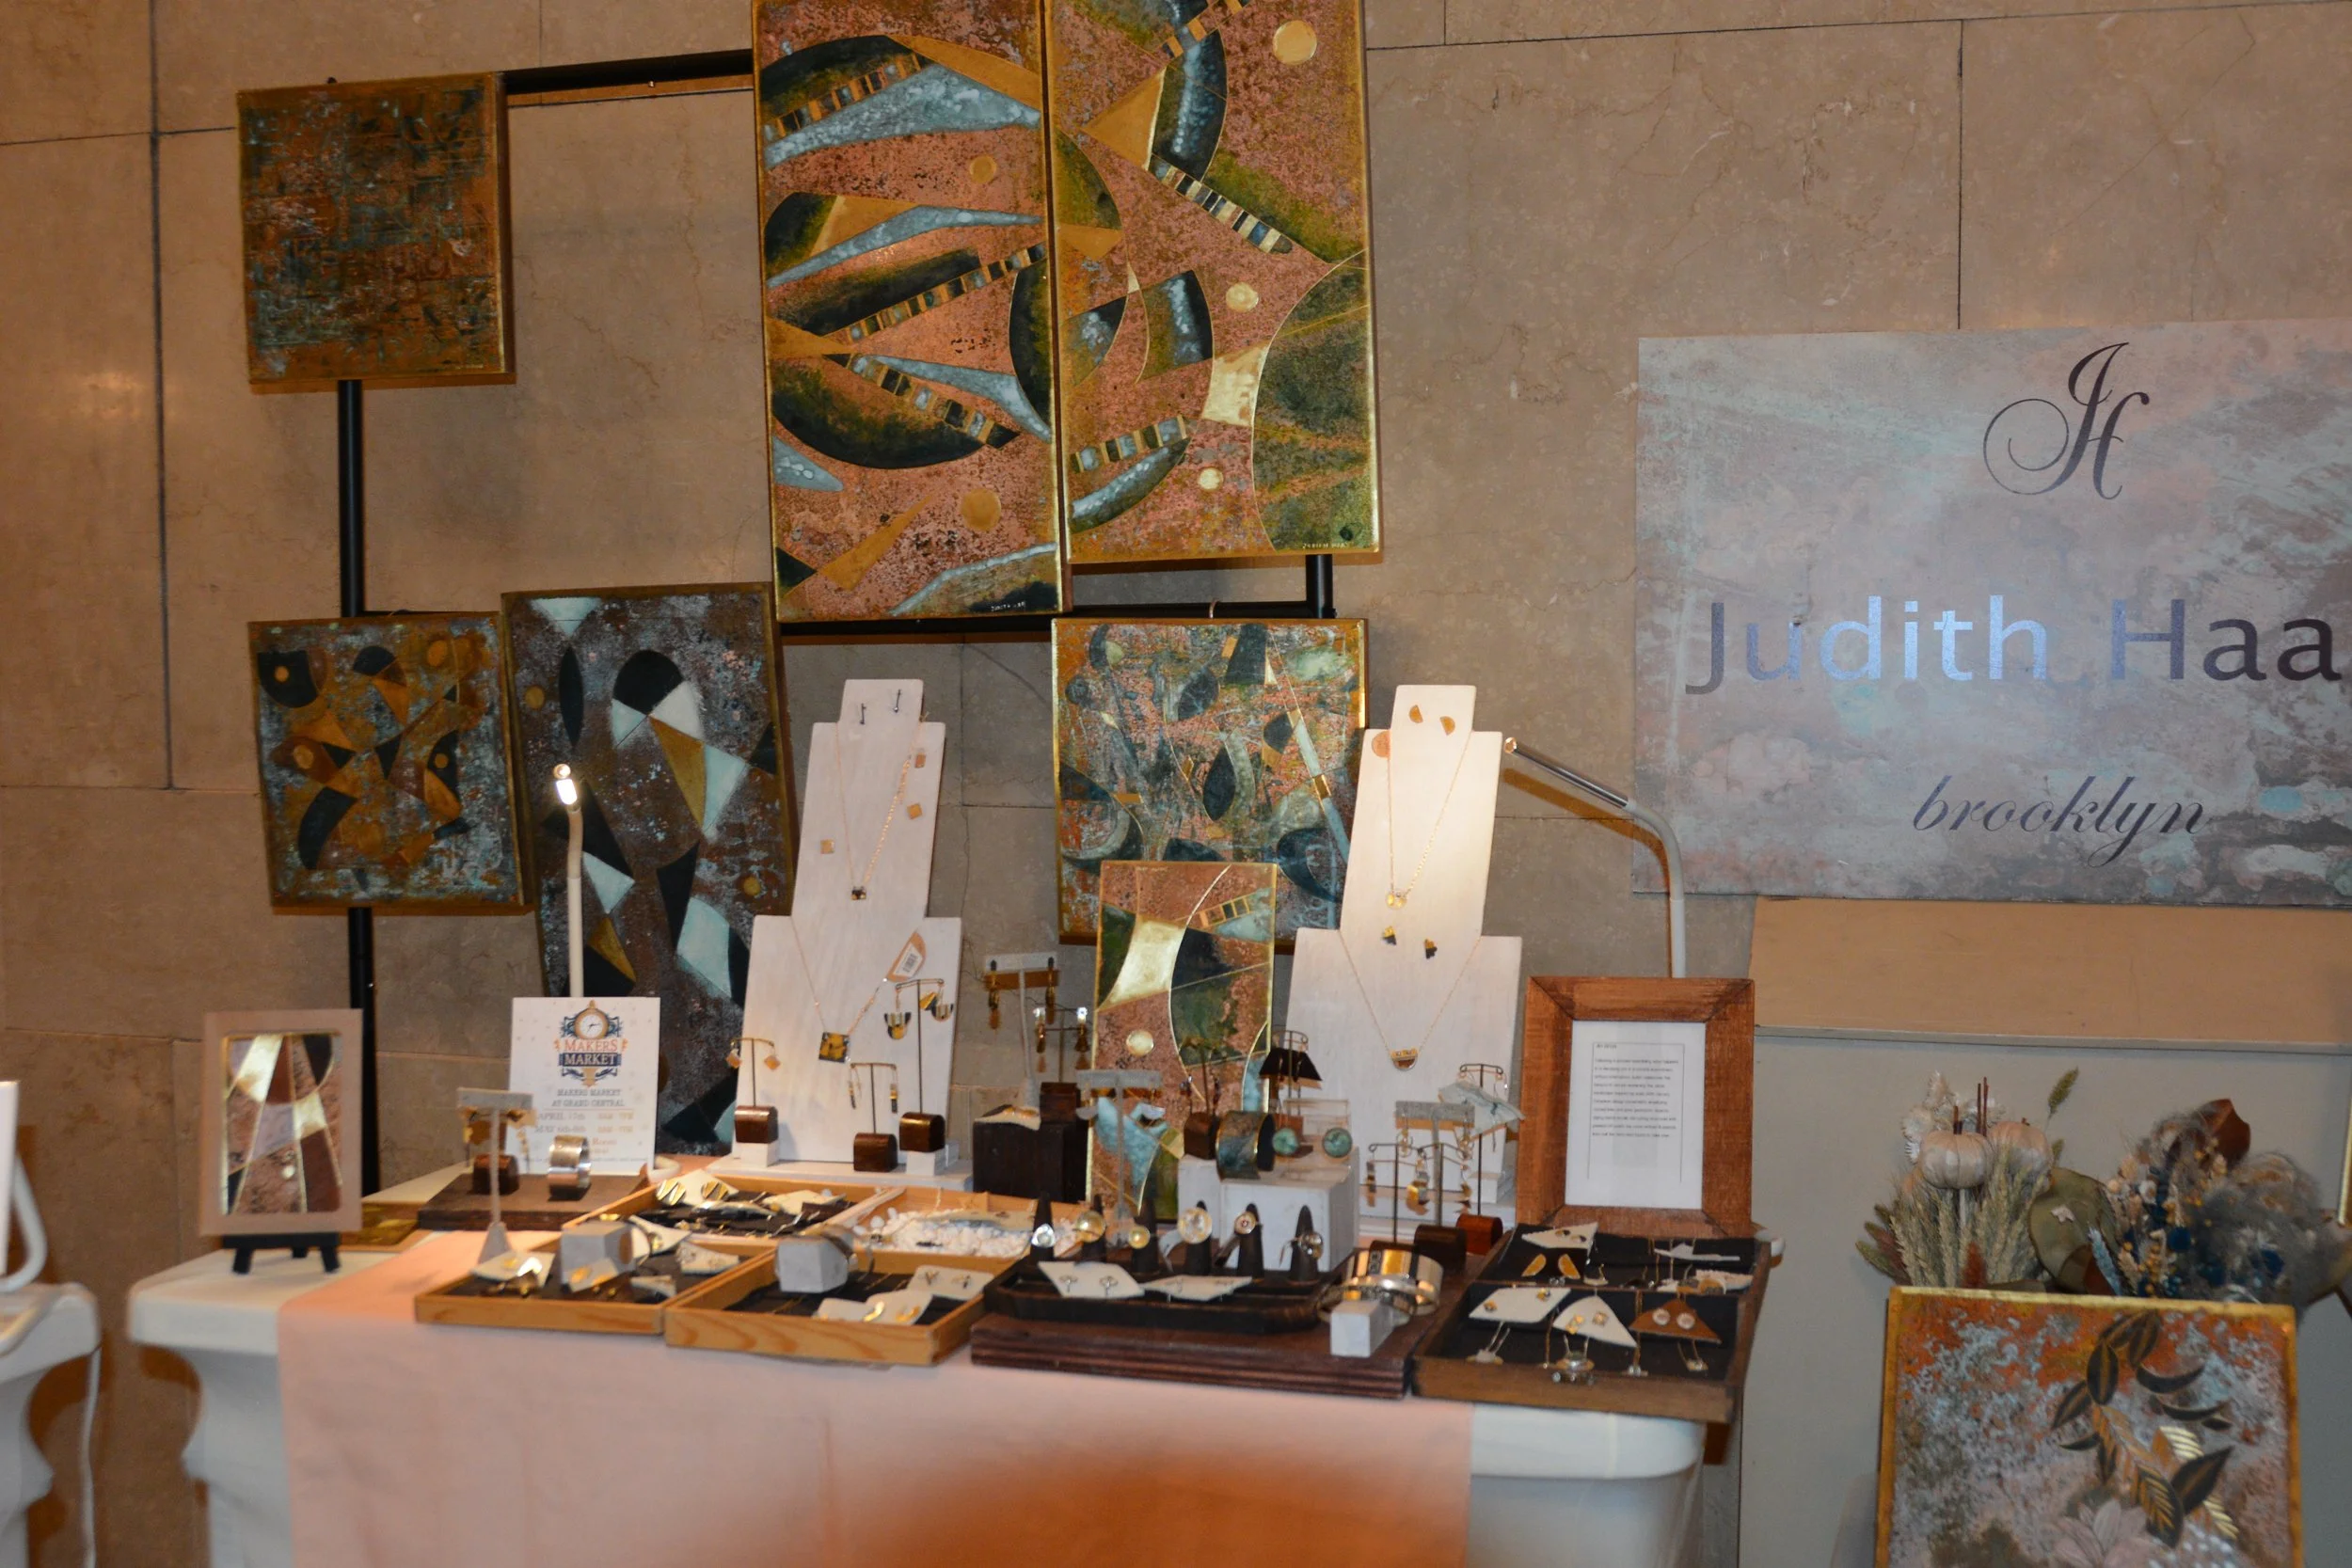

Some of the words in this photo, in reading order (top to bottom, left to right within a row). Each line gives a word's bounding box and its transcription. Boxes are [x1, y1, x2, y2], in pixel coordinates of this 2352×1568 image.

[1685, 594, 2048, 695] Judith
[2111, 597, 2343, 683] Haa
[1912, 775, 2208, 868] brooklyn
[564, 1037, 618, 1052] MAKERS
[564, 1053, 617, 1065] MARKET
